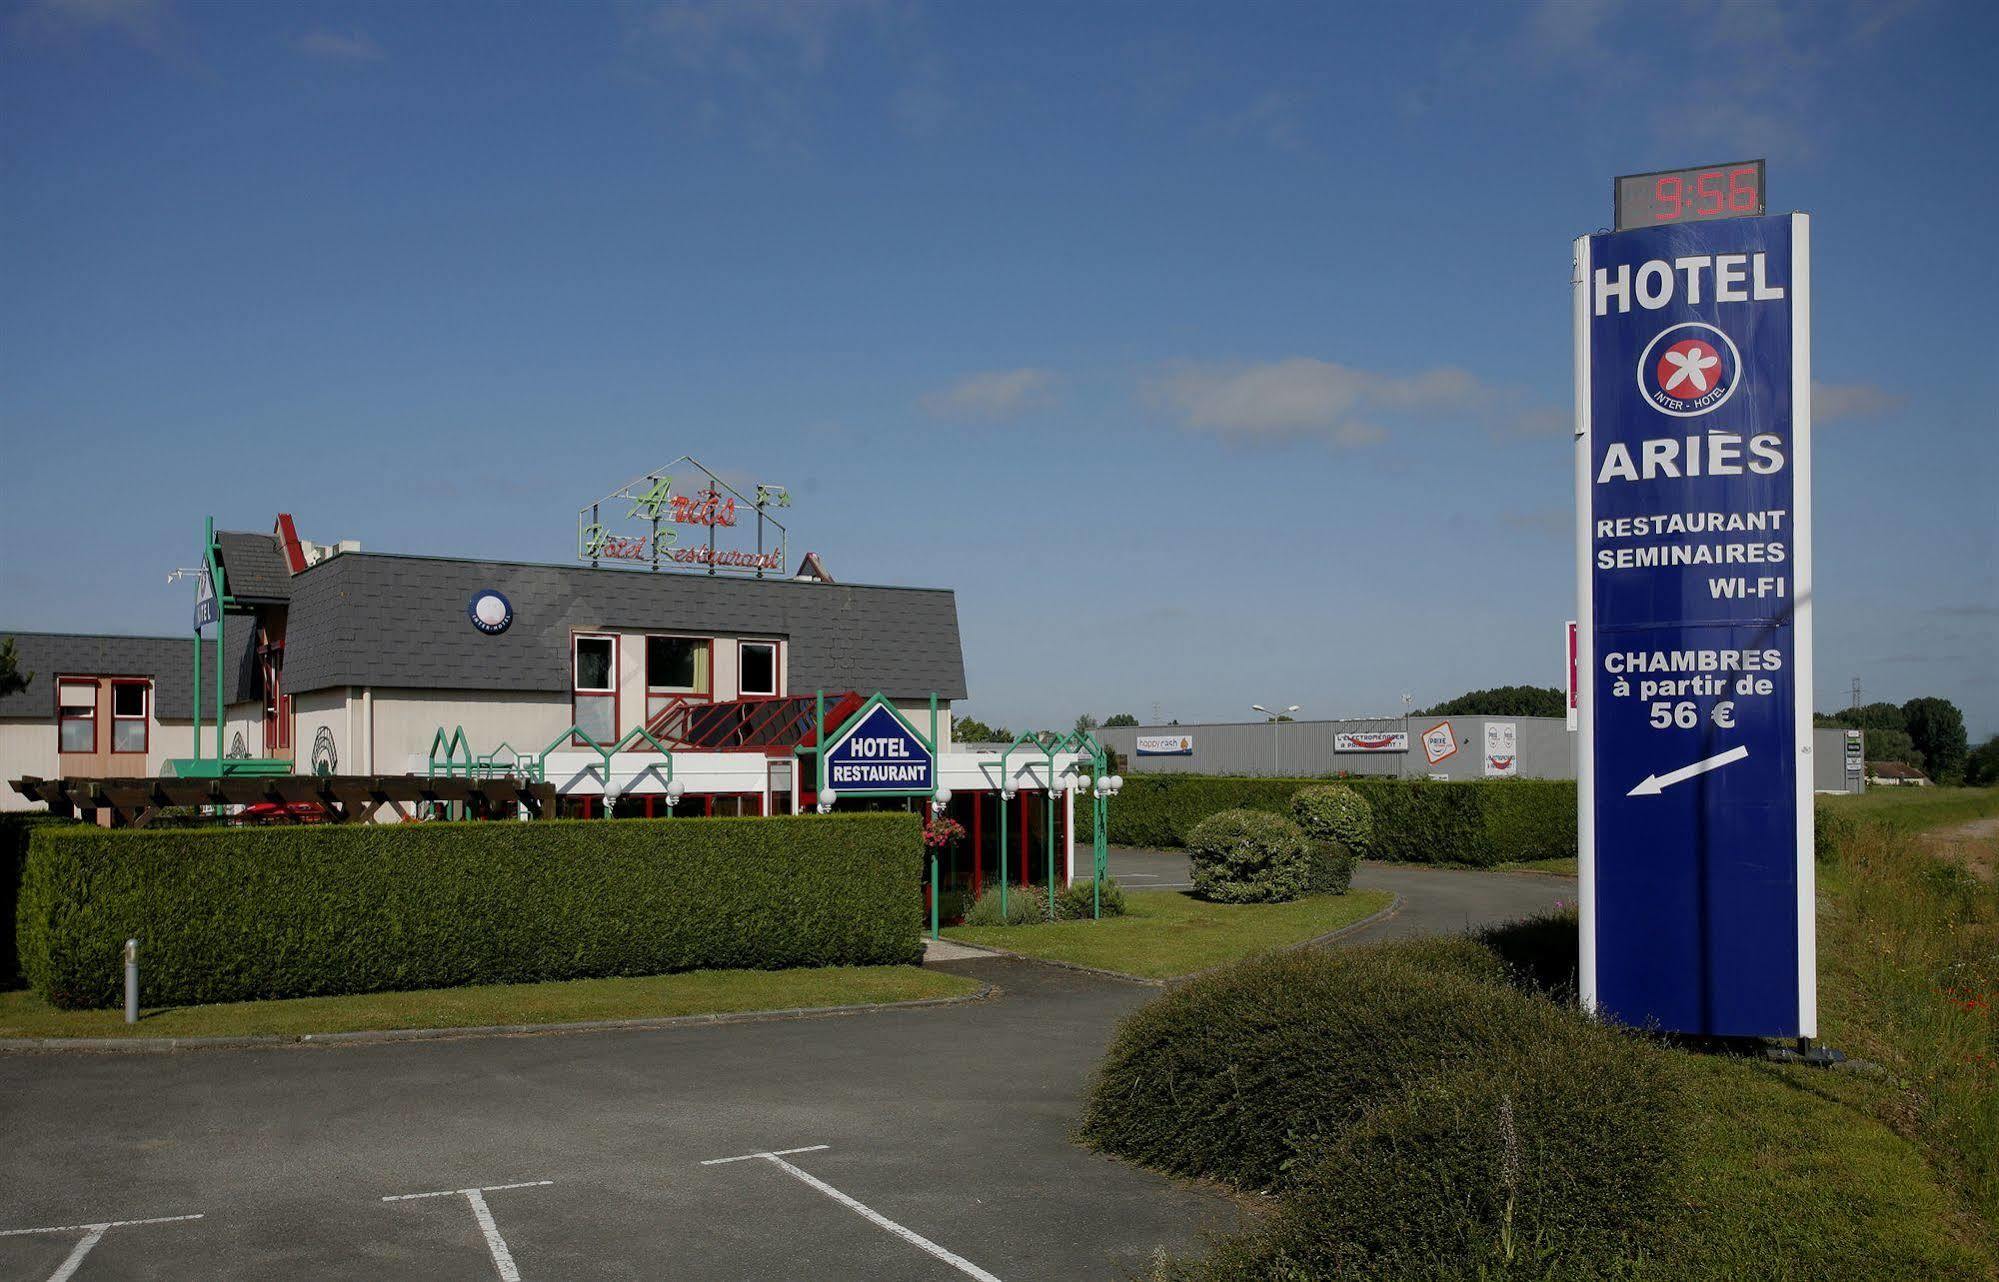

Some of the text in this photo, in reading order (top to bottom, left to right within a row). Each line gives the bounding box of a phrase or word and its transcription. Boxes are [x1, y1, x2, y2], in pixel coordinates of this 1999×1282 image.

[1655, 168, 1758, 221] 9:56
[1595, 252, 1785, 316] HOTEL
[1654, 390, 1683, 411] INTER
[1694, 387, 1726, 409] HOTEL
[1597, 510, 1786, 538] RESTAURANT
[1597, 543, 1785, 569] SEMINAIRES
[1708, 577, 1785, 599] WI-FI
[1604, 649, 1782, 674] CHAMBRES
[1612, 674, 1773, 701] à partir de
[1650, 702, 1735, 729] 56 €
[850, 737, 910, 758] HOTEL
[833, 765, 927, 782] RESTAURANT
